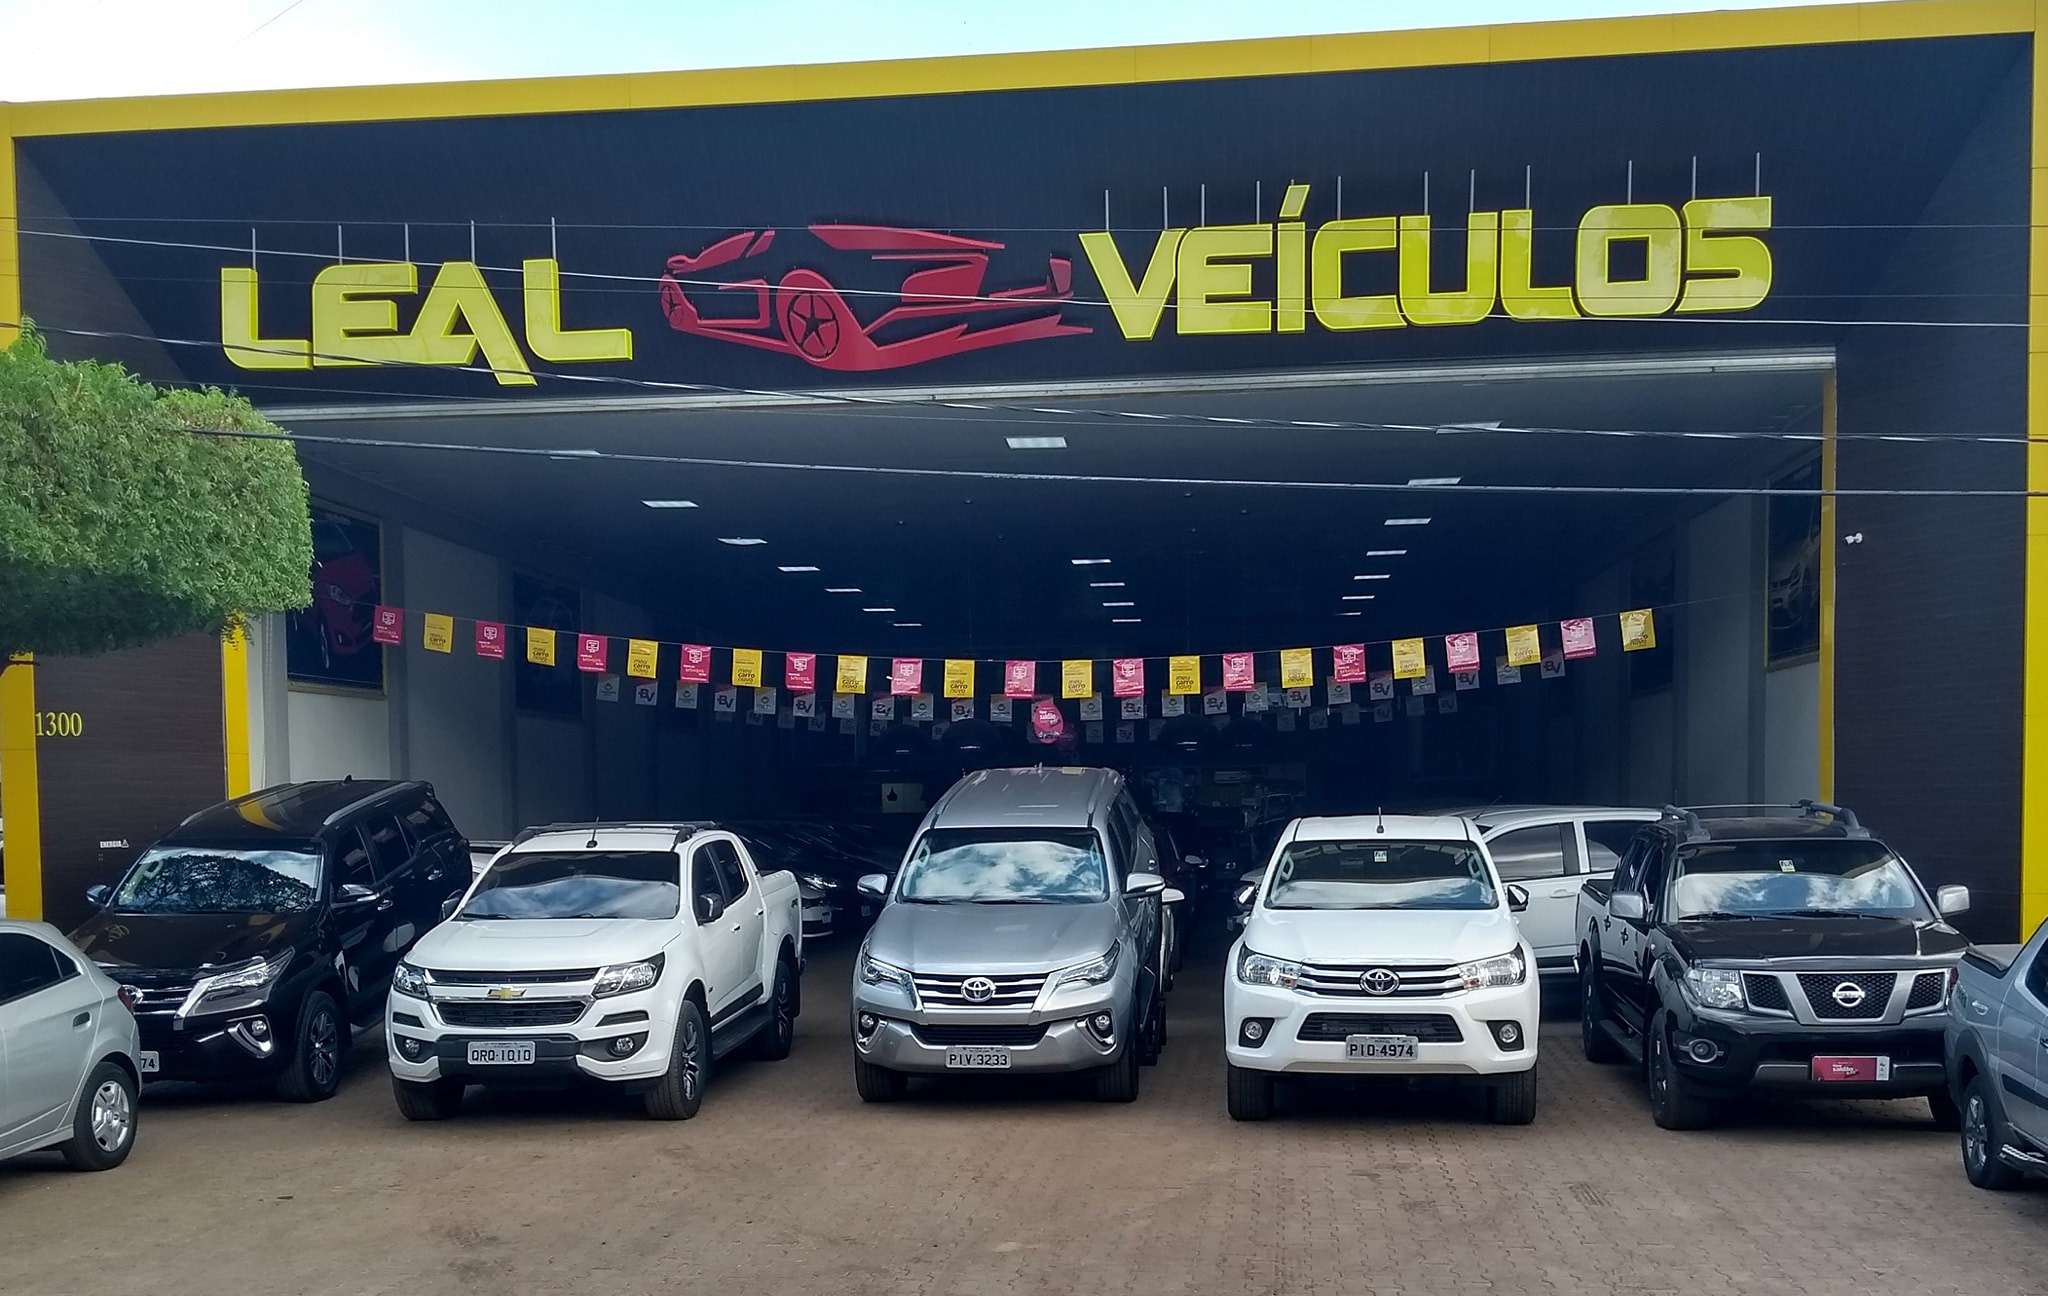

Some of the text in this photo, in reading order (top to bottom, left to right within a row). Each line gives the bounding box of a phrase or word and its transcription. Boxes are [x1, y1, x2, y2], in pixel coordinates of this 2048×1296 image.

[221, 184, 1773, 386] LEAL VEÍCULOS
[35, 711, 83, 737] 1300
